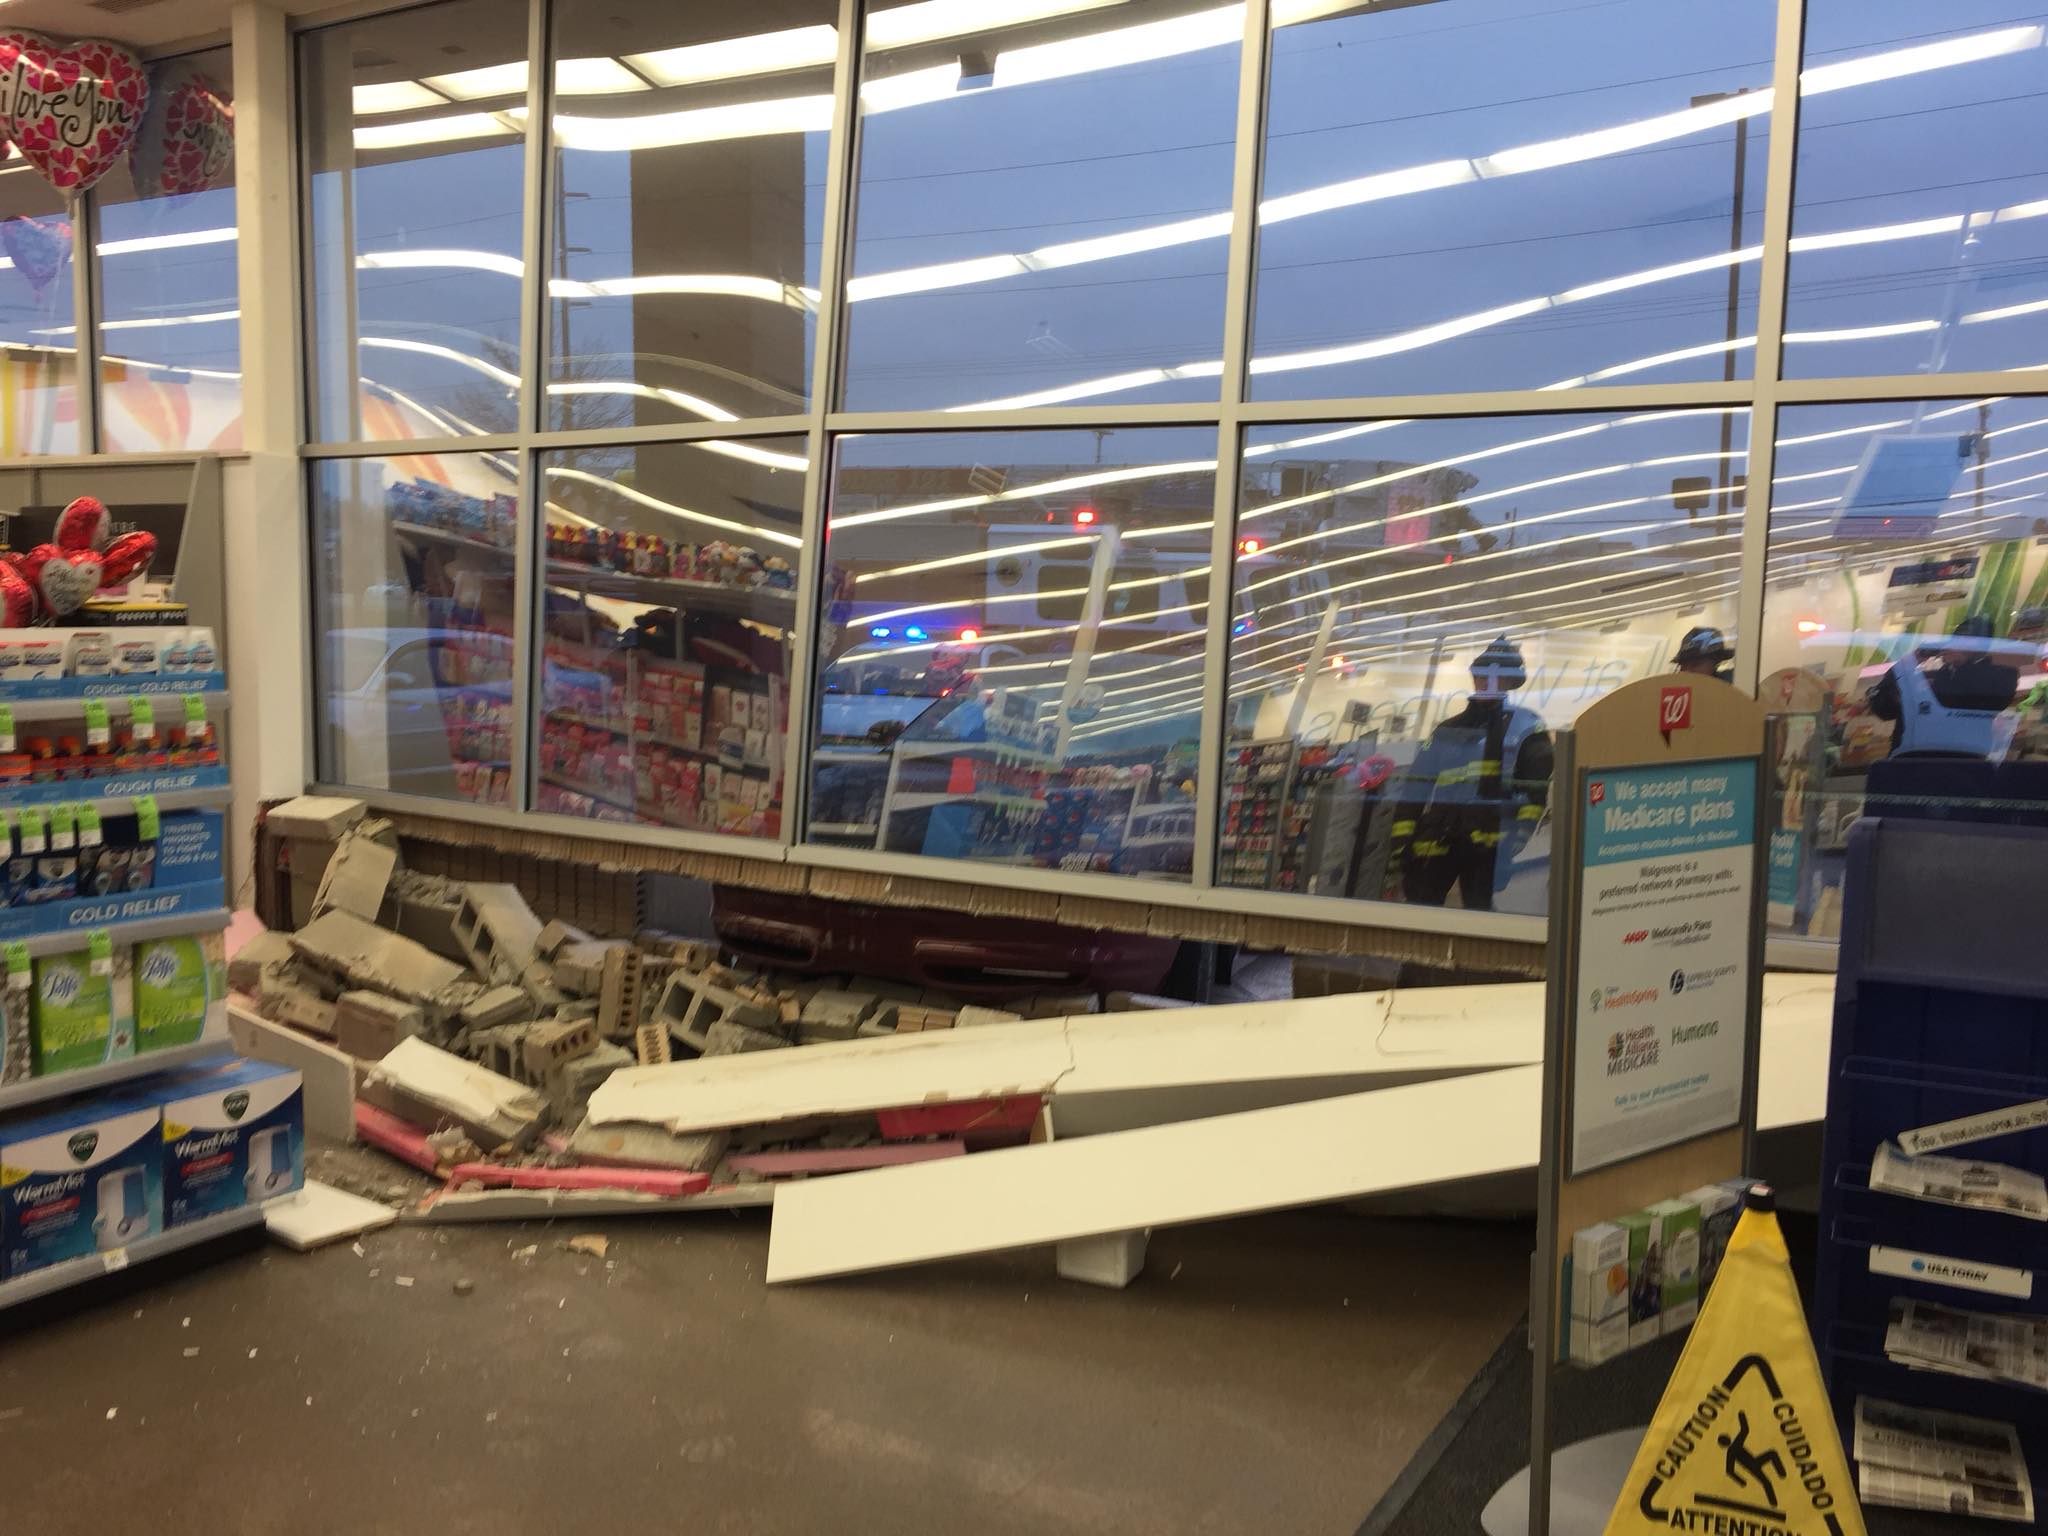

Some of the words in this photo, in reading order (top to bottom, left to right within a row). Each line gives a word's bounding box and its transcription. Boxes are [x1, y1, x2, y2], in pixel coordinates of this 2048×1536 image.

[1614, 780, 1637, 801] We
[1640, 777, 1688, 800] accept
[1691, 776, 1728, 795] many
[1604, 802, 1686, 833] Medicare
[1690, 798, 1736, 828] plans
[1640, 863, 1681, 878] Walgreens
[69, 904, 119, 925] COLD
[121, 895, 181, 918] RELIEF
[1607, 1050, 1659, 1077] MEDICARE
[1928, 1263, 1949, 1276] USA
[1951, 1267, 1988, 1282] TODAY
[1655, 1384, 1731, 1480] CAUTION
[1773, 1402, 1834, 1510] CUIDADO
[1670, 1507, 1802, 1536] ATTENTI
